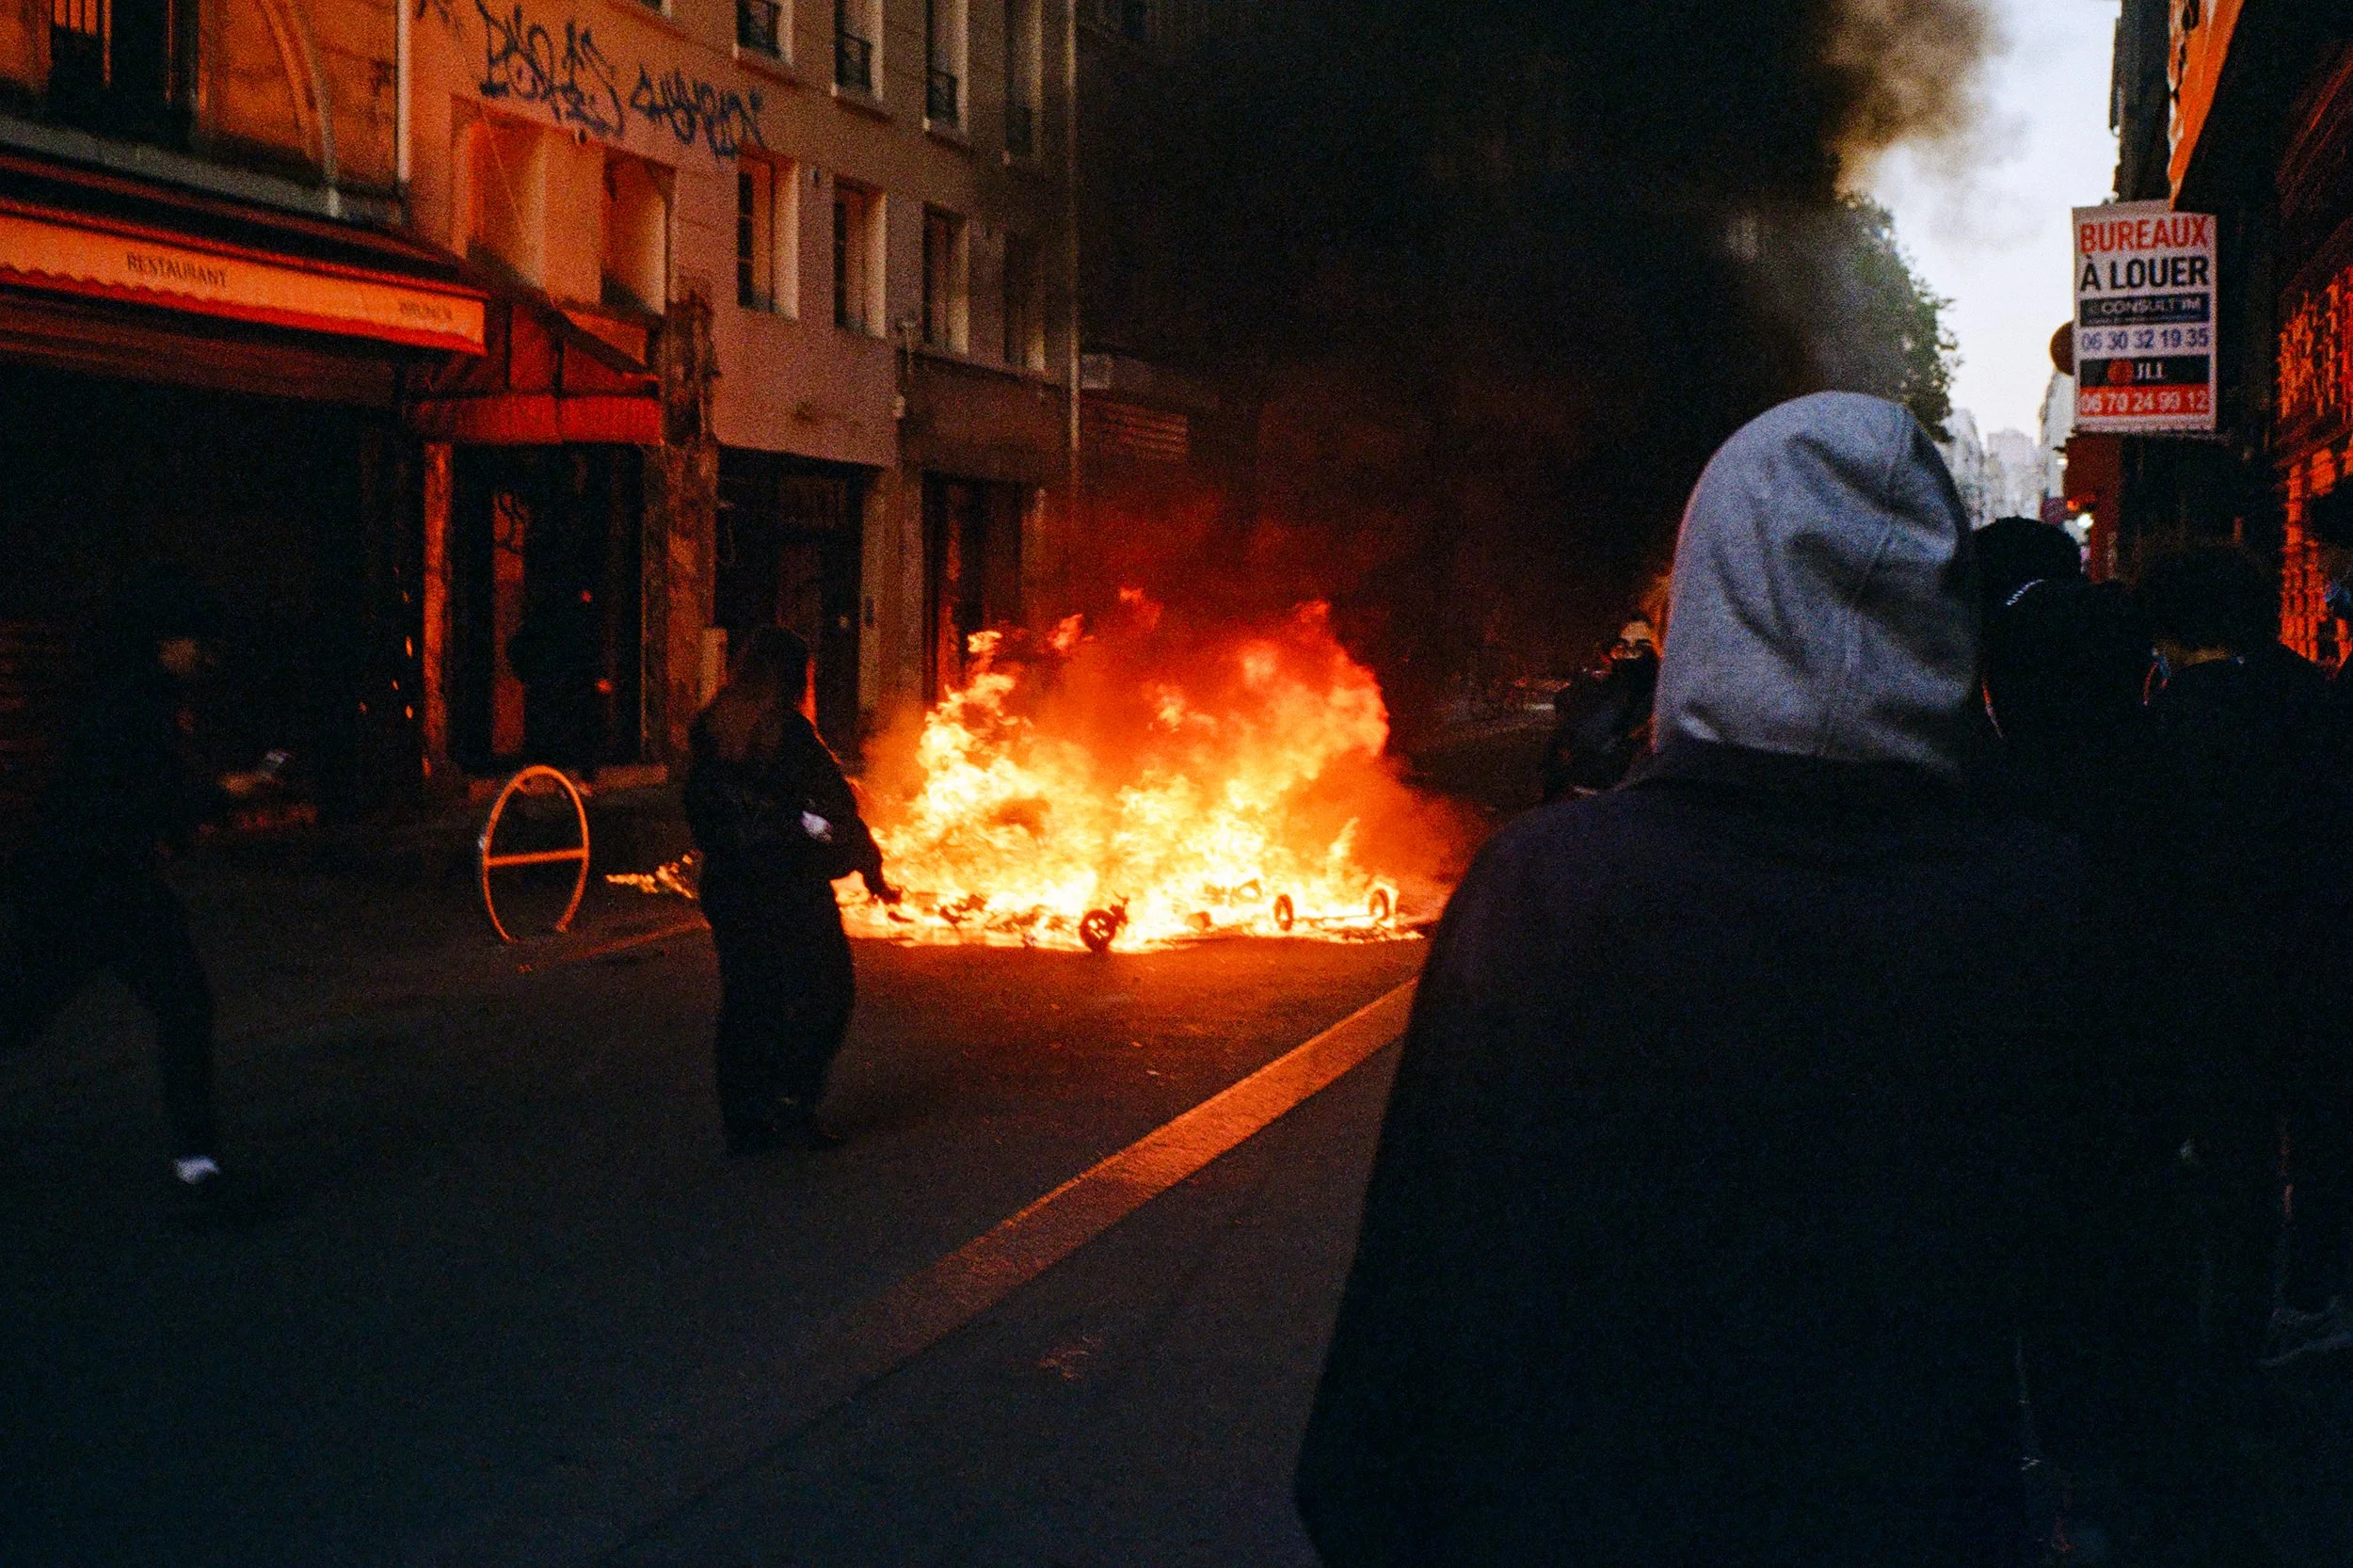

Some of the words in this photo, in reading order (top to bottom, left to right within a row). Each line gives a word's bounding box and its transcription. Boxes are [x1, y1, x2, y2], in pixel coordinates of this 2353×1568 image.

[2080, 215, 2208, 254] BUREAUX
[126, 251, 227, 288] RESTAURANT
[2080, 253, 2101, 291] À
[2110, 255, 2209, 290] LOUER
[2081, 331, 2103, 351] 06
[2108, 330, 2128, 350] 30
[2133, 328, 2154, 349] 32
[2161, 328, 2182, 348] 19
[2185, 327, 2208, 347] 35
[2108, 392, 2128, 412] 70
[2132, 392, 2155, 412] 24
[2186, 390, 2209, 410] 12
